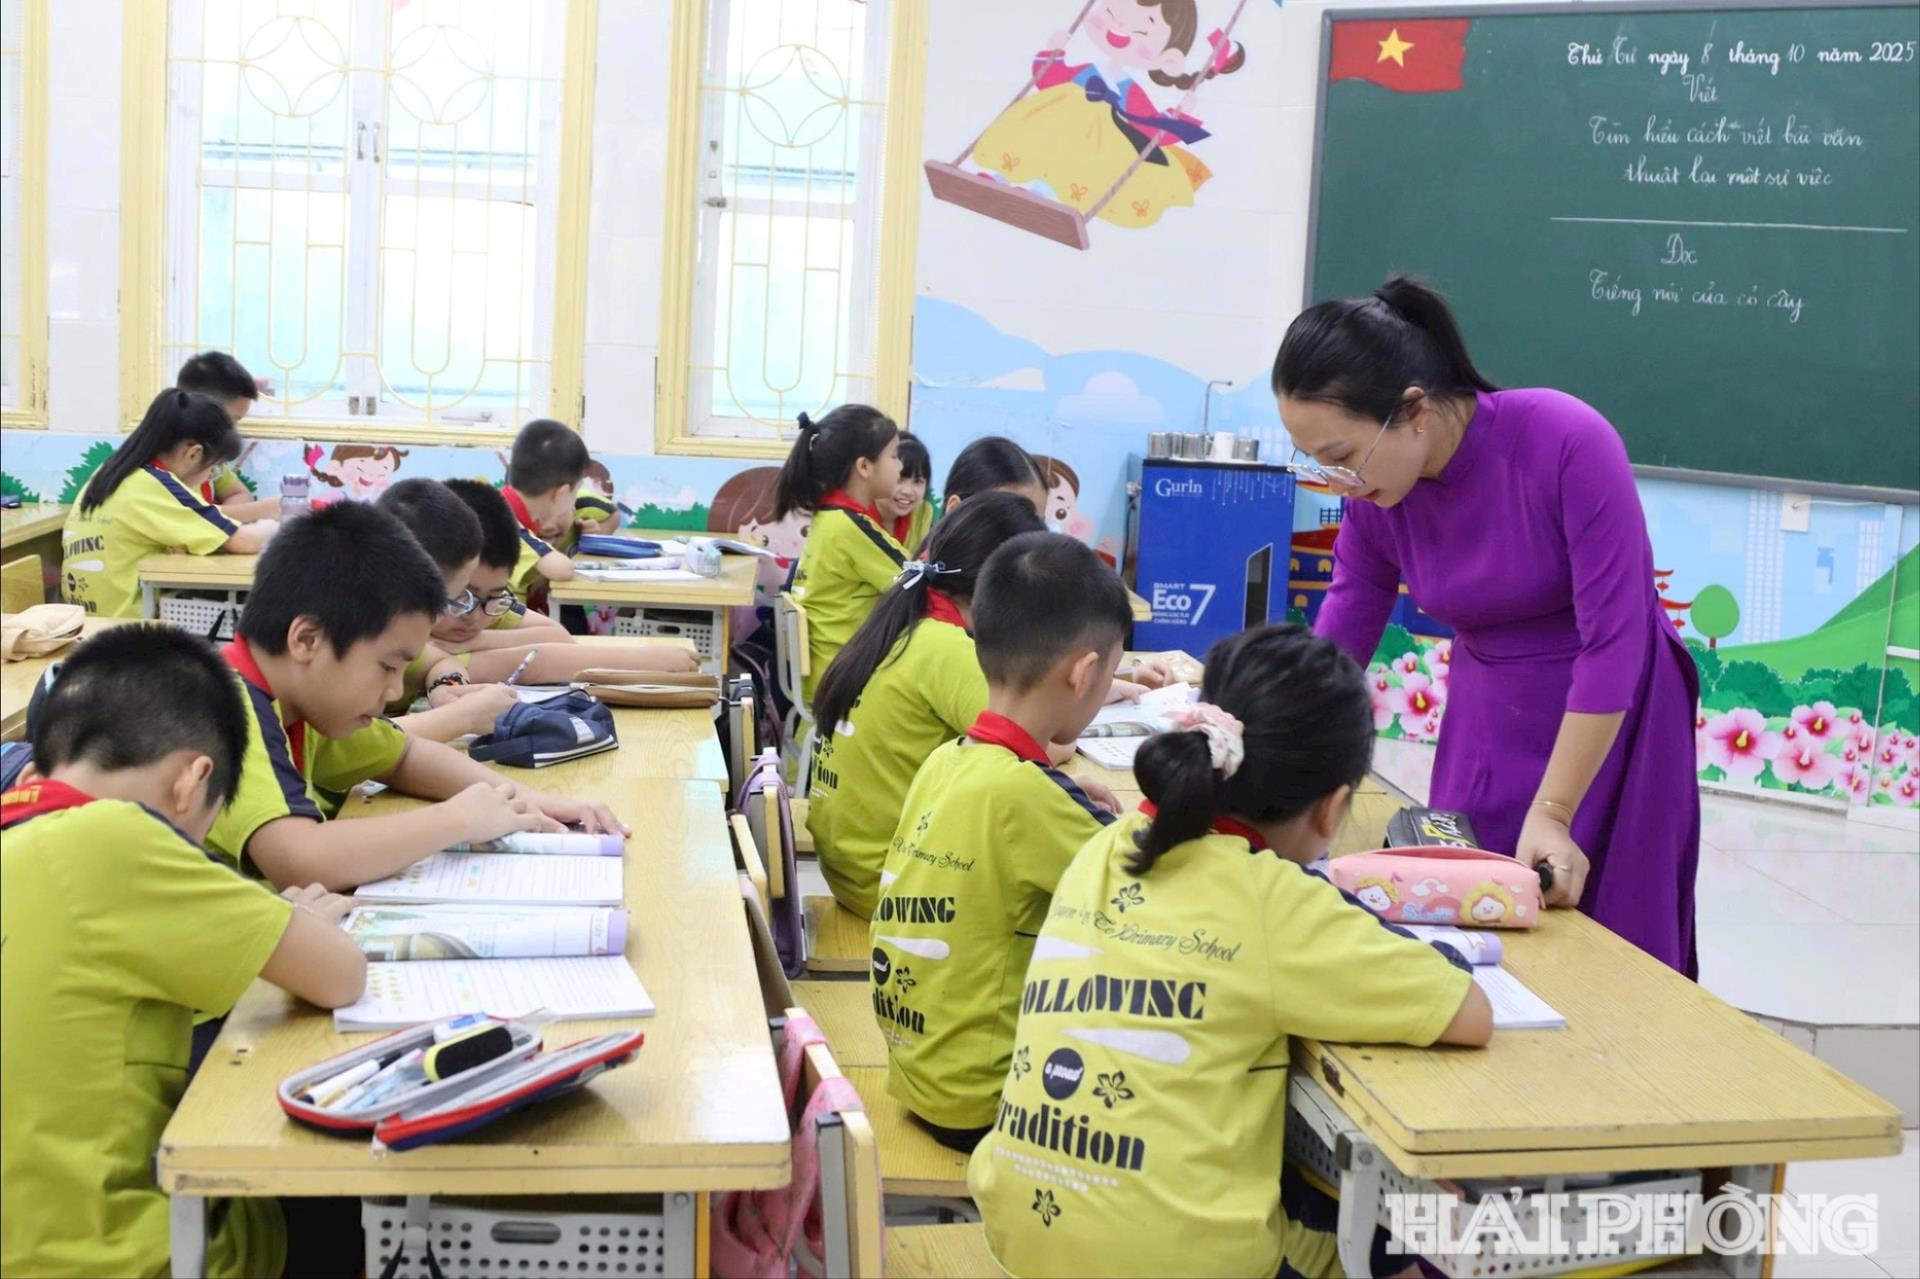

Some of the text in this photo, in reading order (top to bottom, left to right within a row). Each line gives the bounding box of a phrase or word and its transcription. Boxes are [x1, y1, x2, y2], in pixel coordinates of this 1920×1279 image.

[1567, 41, 1603, 65] Thứ
[1648, 50, 1690, 75] ngày
[1701, 43, 1713, 64] 8
[1729, 41, 1781, 76] tháng
[1786, 43, 1805, 64] 10
[1816, 48, 1862, 63] năm
[1868, 41, 1917, 63] 2025
[1682, 74, 1719, 103] Viết
[1589, 113, 1864, 147] Tìm hiểu cách viết bài văn
[1625, 154, 1680, 184] thuật
[1660, 232, 1698, 266] Đọc
[1589, 268, 1804, 323] Tiếng nói của cỏ cây
[1155, 478, 1203, 497] Gurin
[1153, 582, 1187, 591] SMART
[1152, 583, 1216, 626] Eco 7
[879, 896, 956, 924] OWING
[1113, 923, 1177, 949] Primary
[1179, 928, 1242, 963] School
[1022, 974, 1207, 1020] OLLOWING
[998, 1099, 1145, 1172] radition
